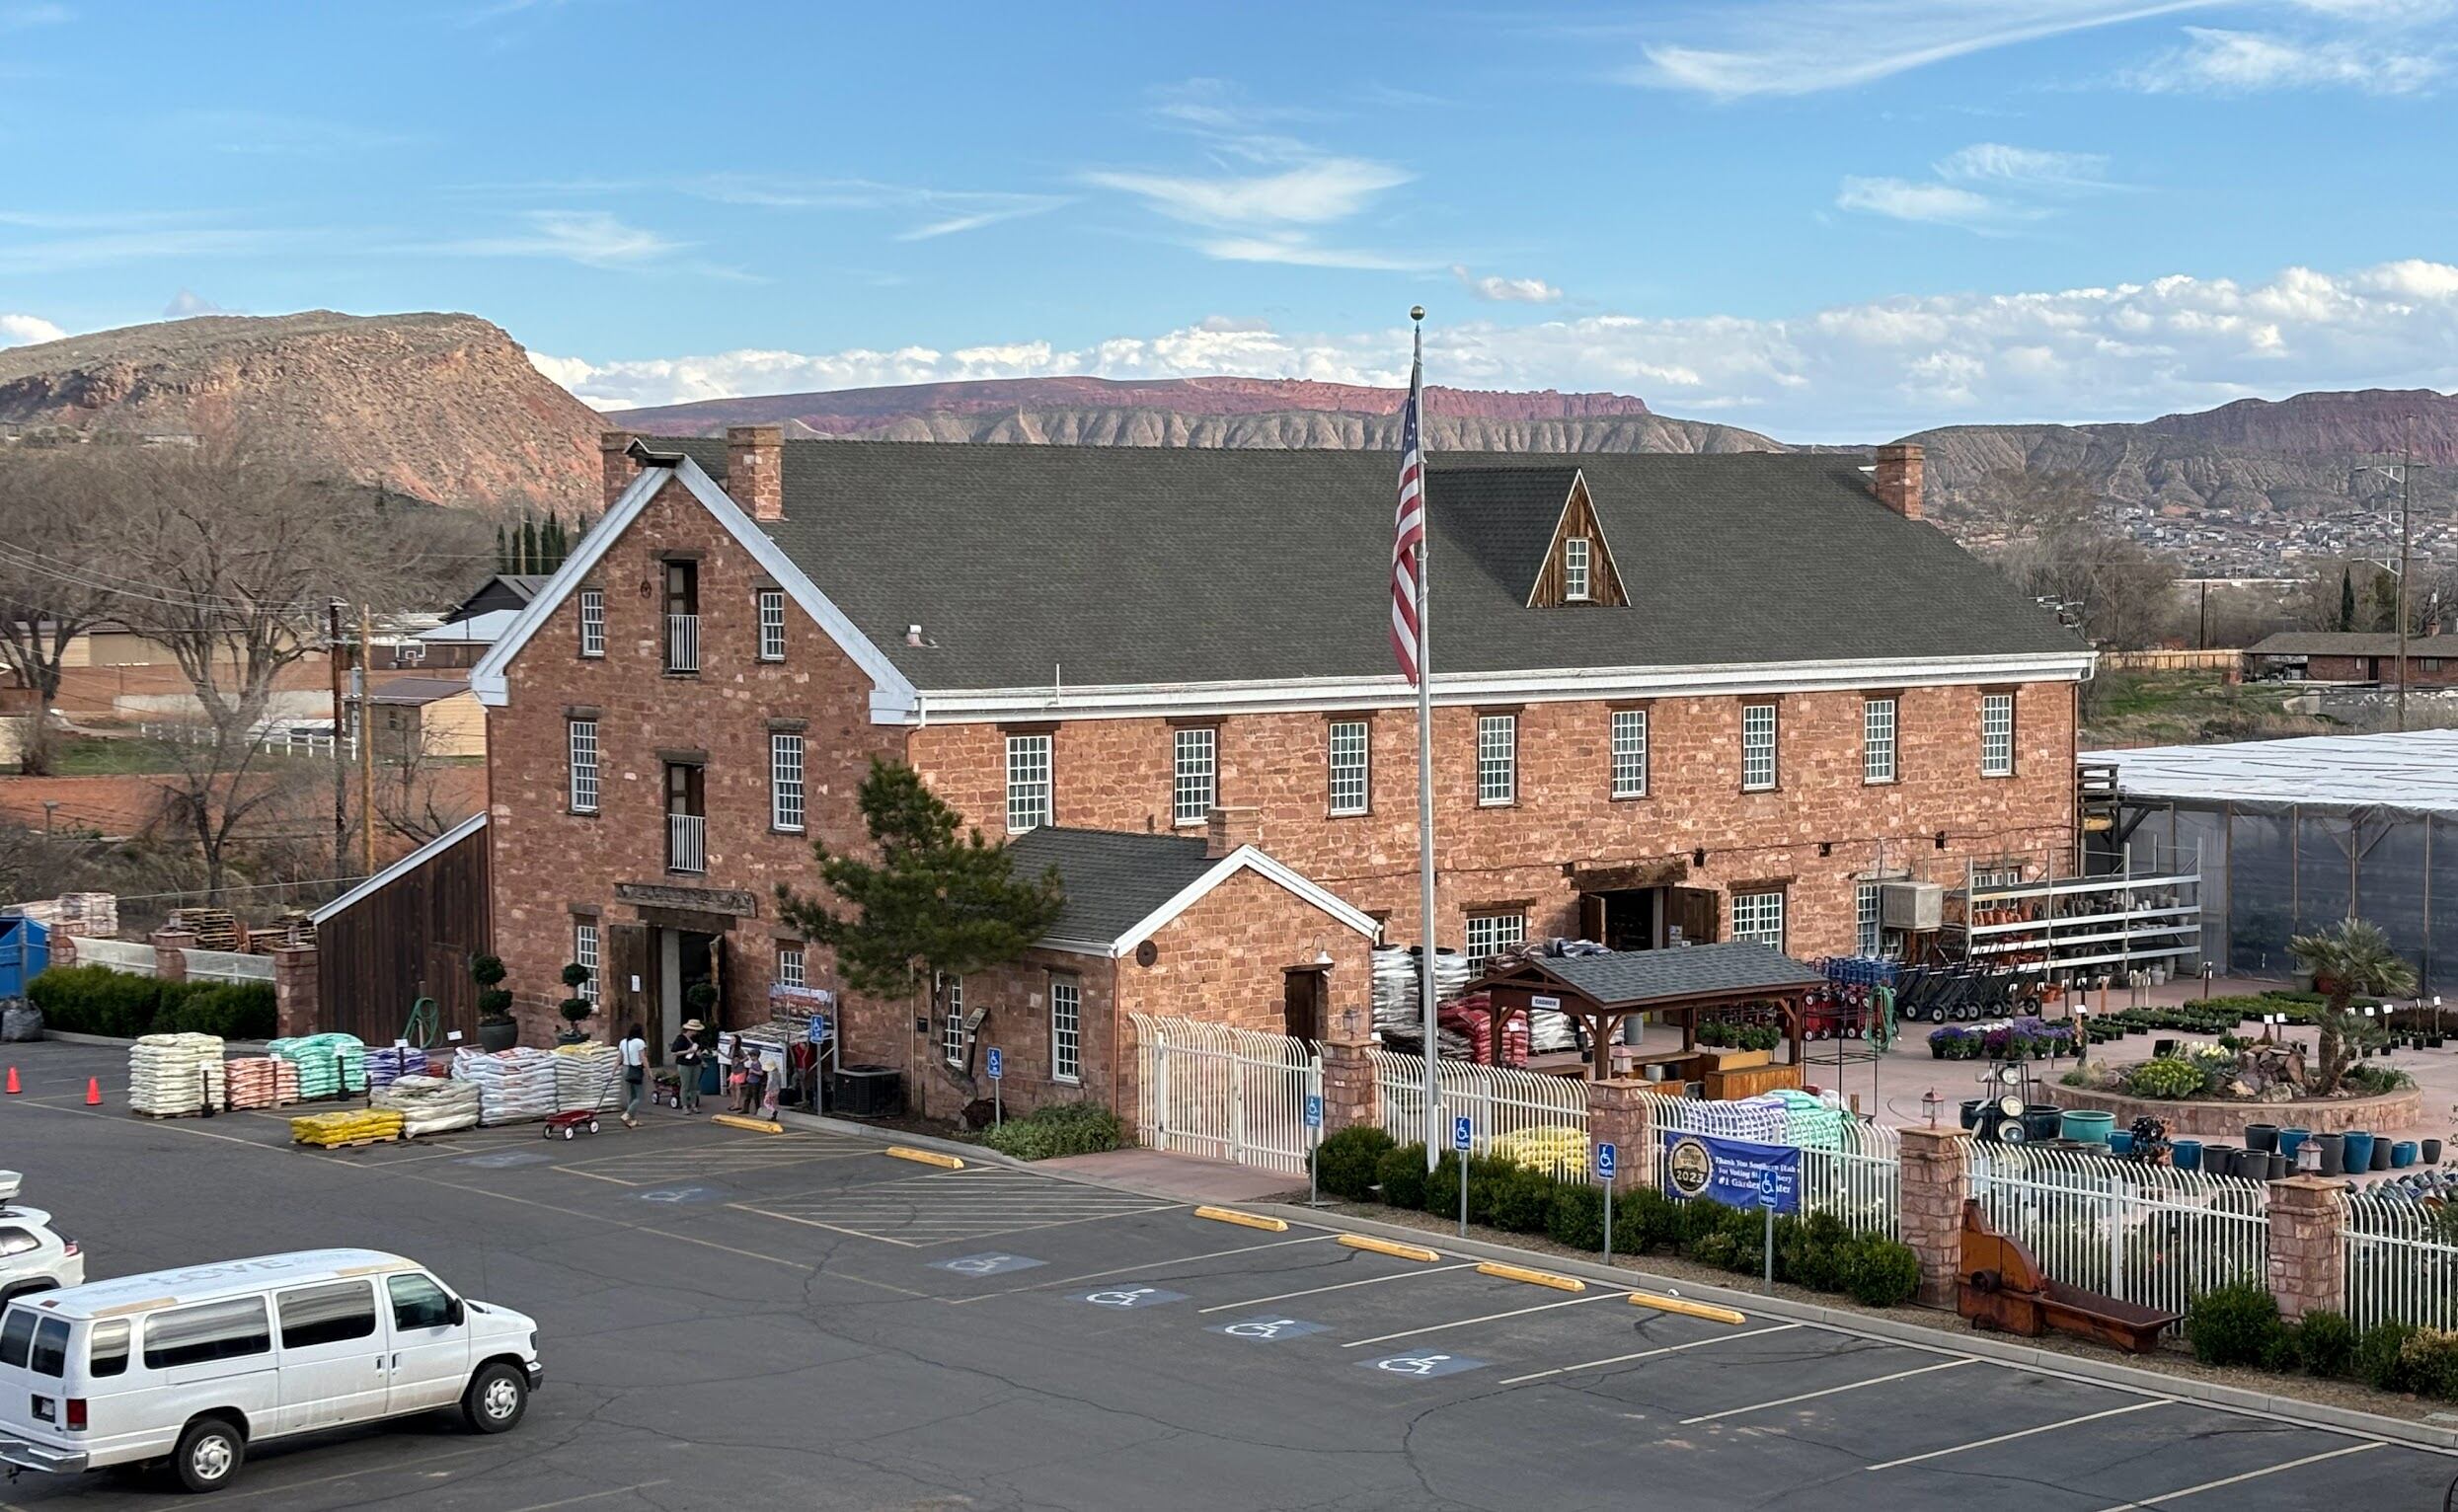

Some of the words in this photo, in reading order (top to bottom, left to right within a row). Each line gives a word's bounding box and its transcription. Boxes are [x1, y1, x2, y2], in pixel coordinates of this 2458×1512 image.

[1715, 1157, 1735, 1166] Thank
[1676, 1170, 1705, 1183] 2023
[1729, 1169, 1750, 1178] Voting
[1719, 1176, 1729, 1185] #1
[148, 1259, 293, 1285] LOVE
